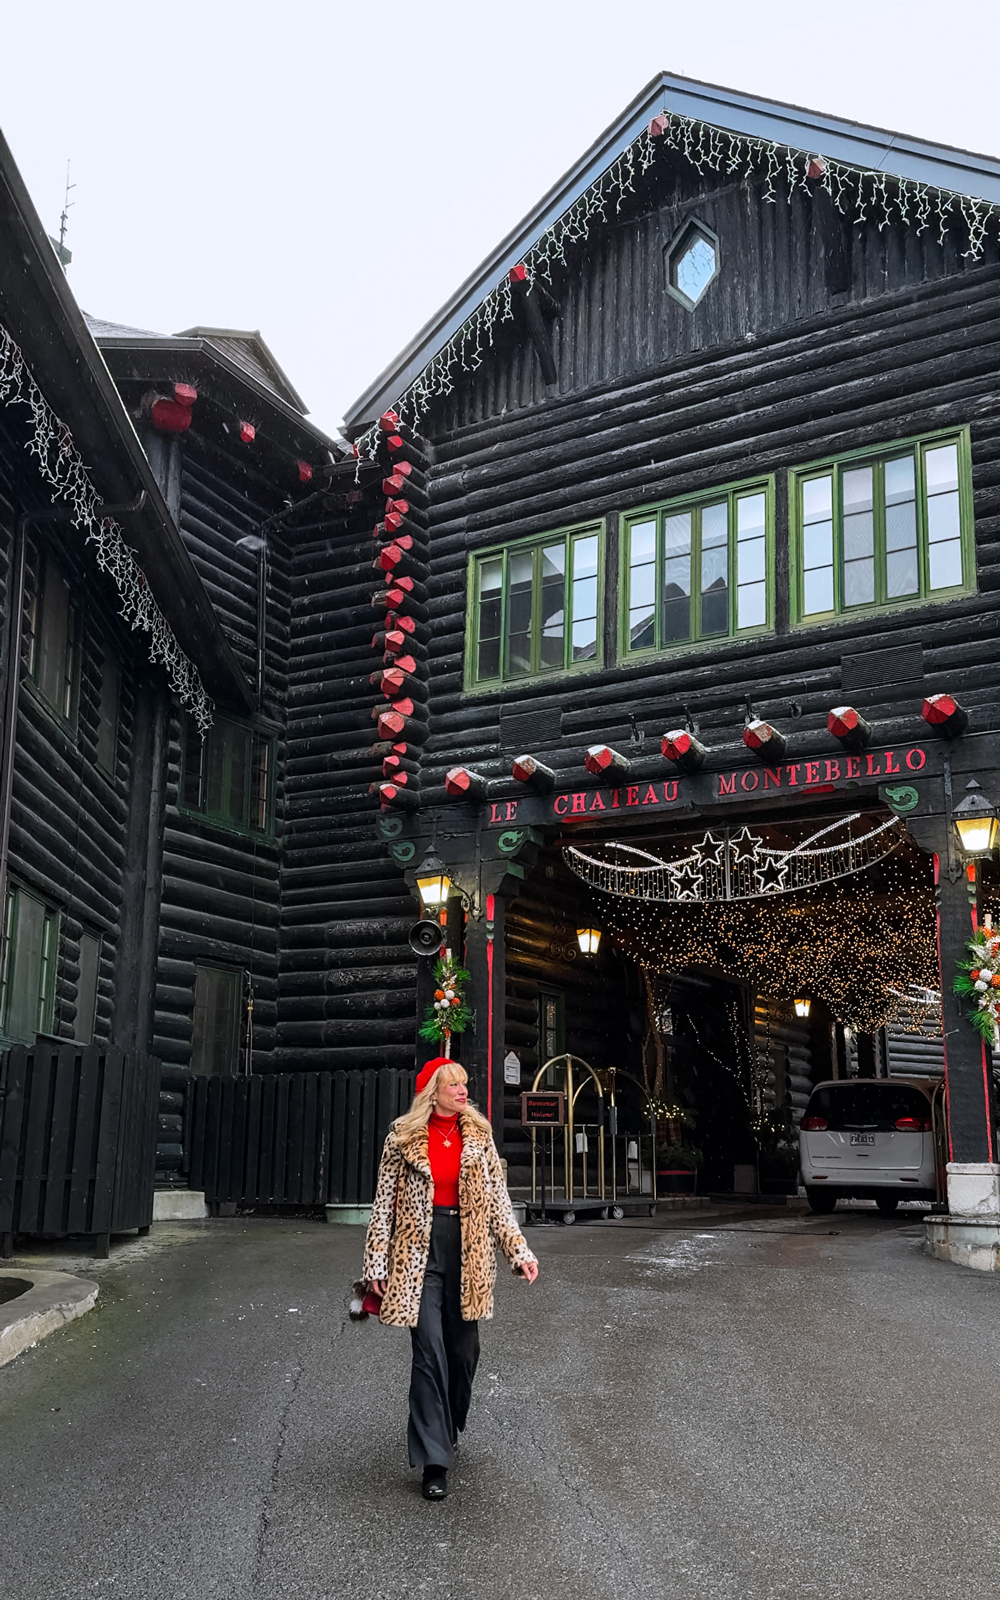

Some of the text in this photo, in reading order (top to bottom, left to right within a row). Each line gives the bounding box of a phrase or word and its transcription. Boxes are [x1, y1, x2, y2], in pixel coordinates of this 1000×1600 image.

[490, 748, 926, 823] LE CHATEAU MONTEBELLO
